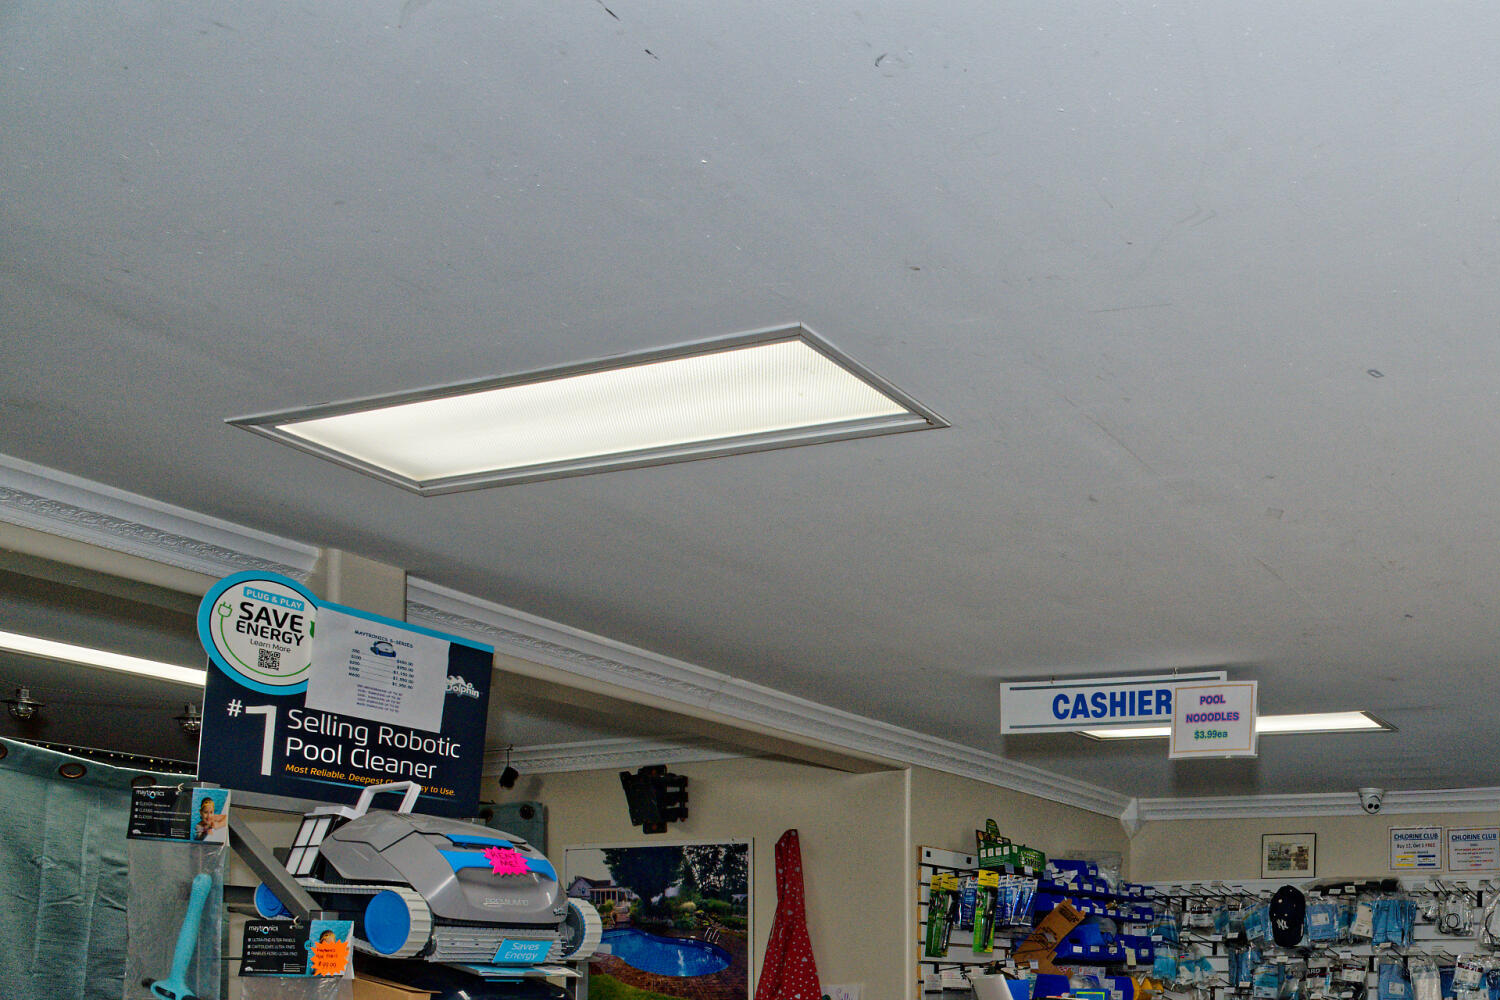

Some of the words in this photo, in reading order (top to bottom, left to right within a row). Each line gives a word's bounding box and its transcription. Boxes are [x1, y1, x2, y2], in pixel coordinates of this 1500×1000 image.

[246, 589, 270, 601] PLUG
[280, 597, 303, 609] PLAY
[238, 601, 304, 633] SAVE
[236, 620, 305, 647] ENERGY
[250, 638, 270, 648] Learn
[272, 643, 291, 654] More
[1052, 689, 1172, 720] CASHIER
[1199, 695, 1226, 705] POOL
[1186, 712, 1239, 723] NOOODLES
[287, 709, 368, 746] Selling
[379, 726, 461, 759] Robotic
[285, 737, 342, 765] Pool
[350, 749, 437, 779] Cleaner
[285, 764, 309, 775] Most
[310, 768, 346, 780] Reliable.
[349, 773, 383, 785] Deepest
[1394, 833, 1422, 841] CHLORINE
[1423, 832, 1439, 841] CLUB
[504, 949, 539, 962] Energy
[511, 941, 540, 952] Saves
